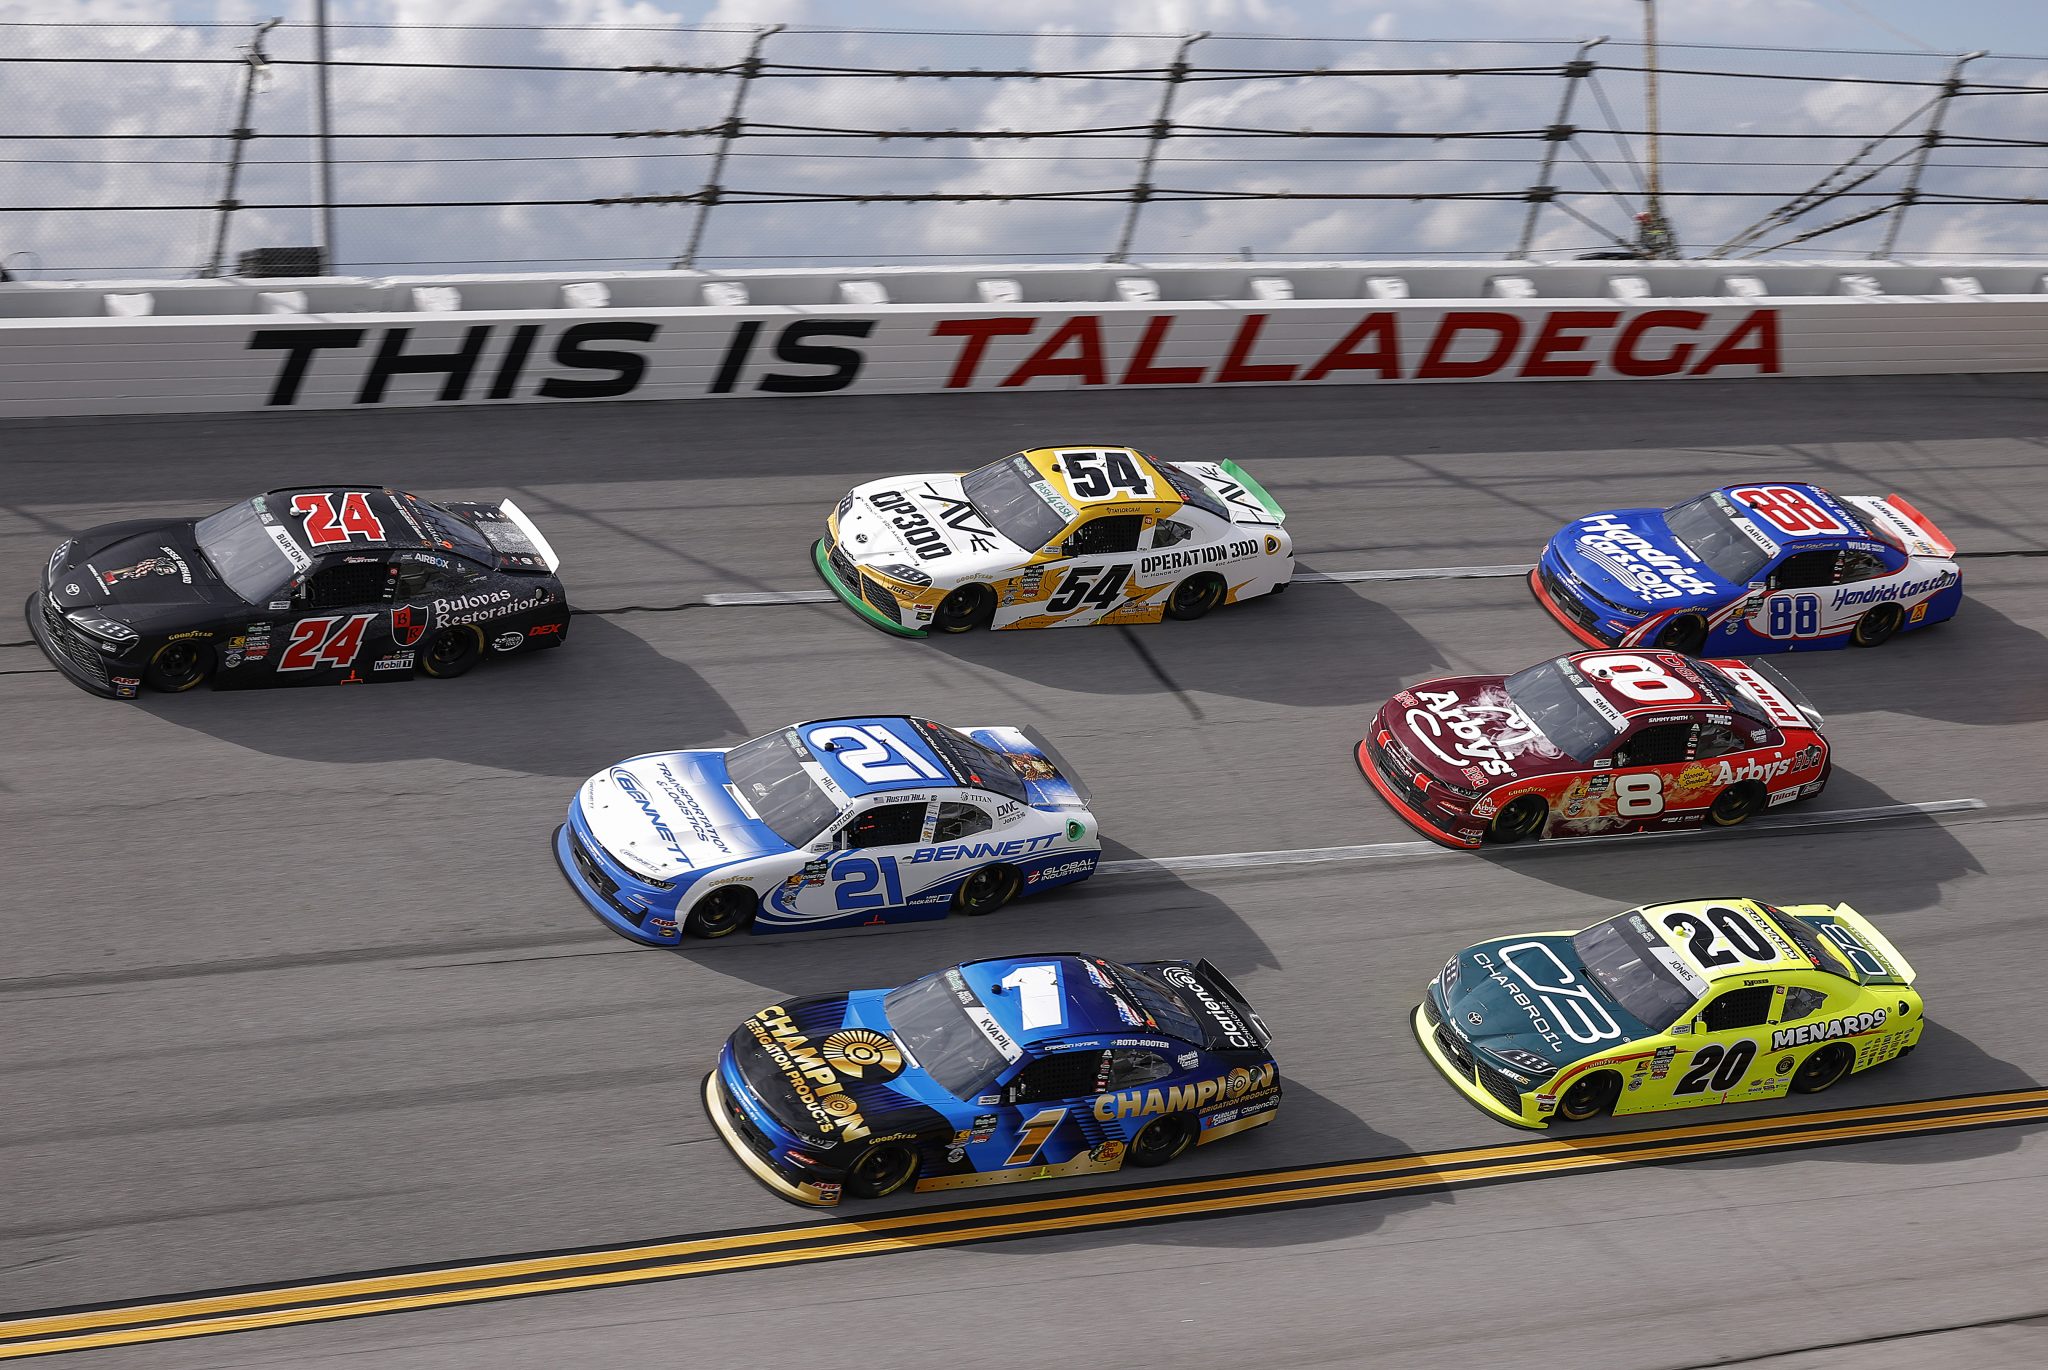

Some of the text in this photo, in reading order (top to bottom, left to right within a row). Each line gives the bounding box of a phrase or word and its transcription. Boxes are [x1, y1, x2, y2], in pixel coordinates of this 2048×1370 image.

[247, 309, 1782, 405] THIS IS TALLADEGA
[1055, 450, 1154, 501] 54
[1035, 482, 1052, 501] DASH
[1054, 500, 1073, 518] CASH
[1731, 486, 1849, 536] 88
[290, 492, 386, 547] 24
[276, 533, 304, 563] BURTON
[1744, 524, 1773, 550] CARUTH
[413, 553, 450, 569] AIRBOX
[1141, 540, 1259, 574] OPERATION 300
[1579, 514, 1717, 596] Hendrick
[956, 572, 993, 584] GOODYEAR
[1045, 563, 1134, 613] 54
[1557, 573, 1584, 601] CHEVROLET
[433, 589, 511, 615] Bulovas
[435, 595, 551, 630] Restorations
[1674, 606, 1708, 615] GOODYEAR
[1769, 594, 1821, 639] 88
[168, 631, 213, 641] GOODYEAR
[276, 613, 379, 672] 24
[529, 623, 562, 636] DEX
[374, 660, 401, 670] Mobil
[1580, 655, 1700, 703] 8
[1593, 698, 1618, 720] SMITH
[1415, 690, 1513, 776] Arby's
[808, 725, 946, 784] 21
[1713, 752, 1791, 786] Arby's
[821, 777, 834, 793] HILL
[1461, 766, 1489, 790] BBQ
[1509, 787, 1546, 795] GOODYEAR
[1615, 772, 1665, 818] 8
[656, 762, 731, 854] TRANSPORTATION
[664, 786, 710, 842] LOGISTICS
[970, 794, 992, 803] TITAN
[996, 800, 1019, 817] DWC
[616, 776, 695, 868] BENNETT
[1003, 815, 1017, 824] John
[912, 832, 1062, 864] BENNETT
[709, 876, 753, 887] GOODYEAR
[832, 856, 904, 910] 21
[1041, 865, 1094, 881] INDUSTRIAL
[1043, 858, 1095, 876] GLOBAL
[1662, 905, 1777, 970] 20
[1742, 906, 1799, 960] MENARDS
[1669, 960, 1694, 982] JONES
[1001, 965, 1062, 1031] 1
[1180, 971, 1250, 1048] Clarience
[1474, 953, 1563, 1053] CHARBROIL
[980, 1018, 1013, 1051] KVAPIL
[1219, 1000, 1259, 1048] TECHNOLOGIES
[1771, 1008, 1887, 1052] MENARDS
[1116, 1039, 1170, 1049] ROTO-ROOTER
[1177, 1051, 1199, 1063] Hendrick
[744, 1018, 795, 1072] IRRIGATION
[786, 1068, 835, 1133] PRODUCTS
[755, 1005, 871, 1143] CHAMPION
[1672, 1039, 1758, 1097] 20
[730, 1082, 759, 1121] CHEVROLET
[1093, 1063, 1274, 1121] CHAMPION
[1199, 1086, 1279, 1115] IRRIGATION PRODUCTS
[1212, 1109, 1238, 1119] CAROLINA
[1214, 1115, 1237, 1126] CARPORTS
[868, 1132, 917, 1146] GOODYEAR
[1003, 1108, 1068, 1166] 1
[1104, 1141, 1119, 1149] Bass
[1101, 1151, 1119, 1159] Shops
